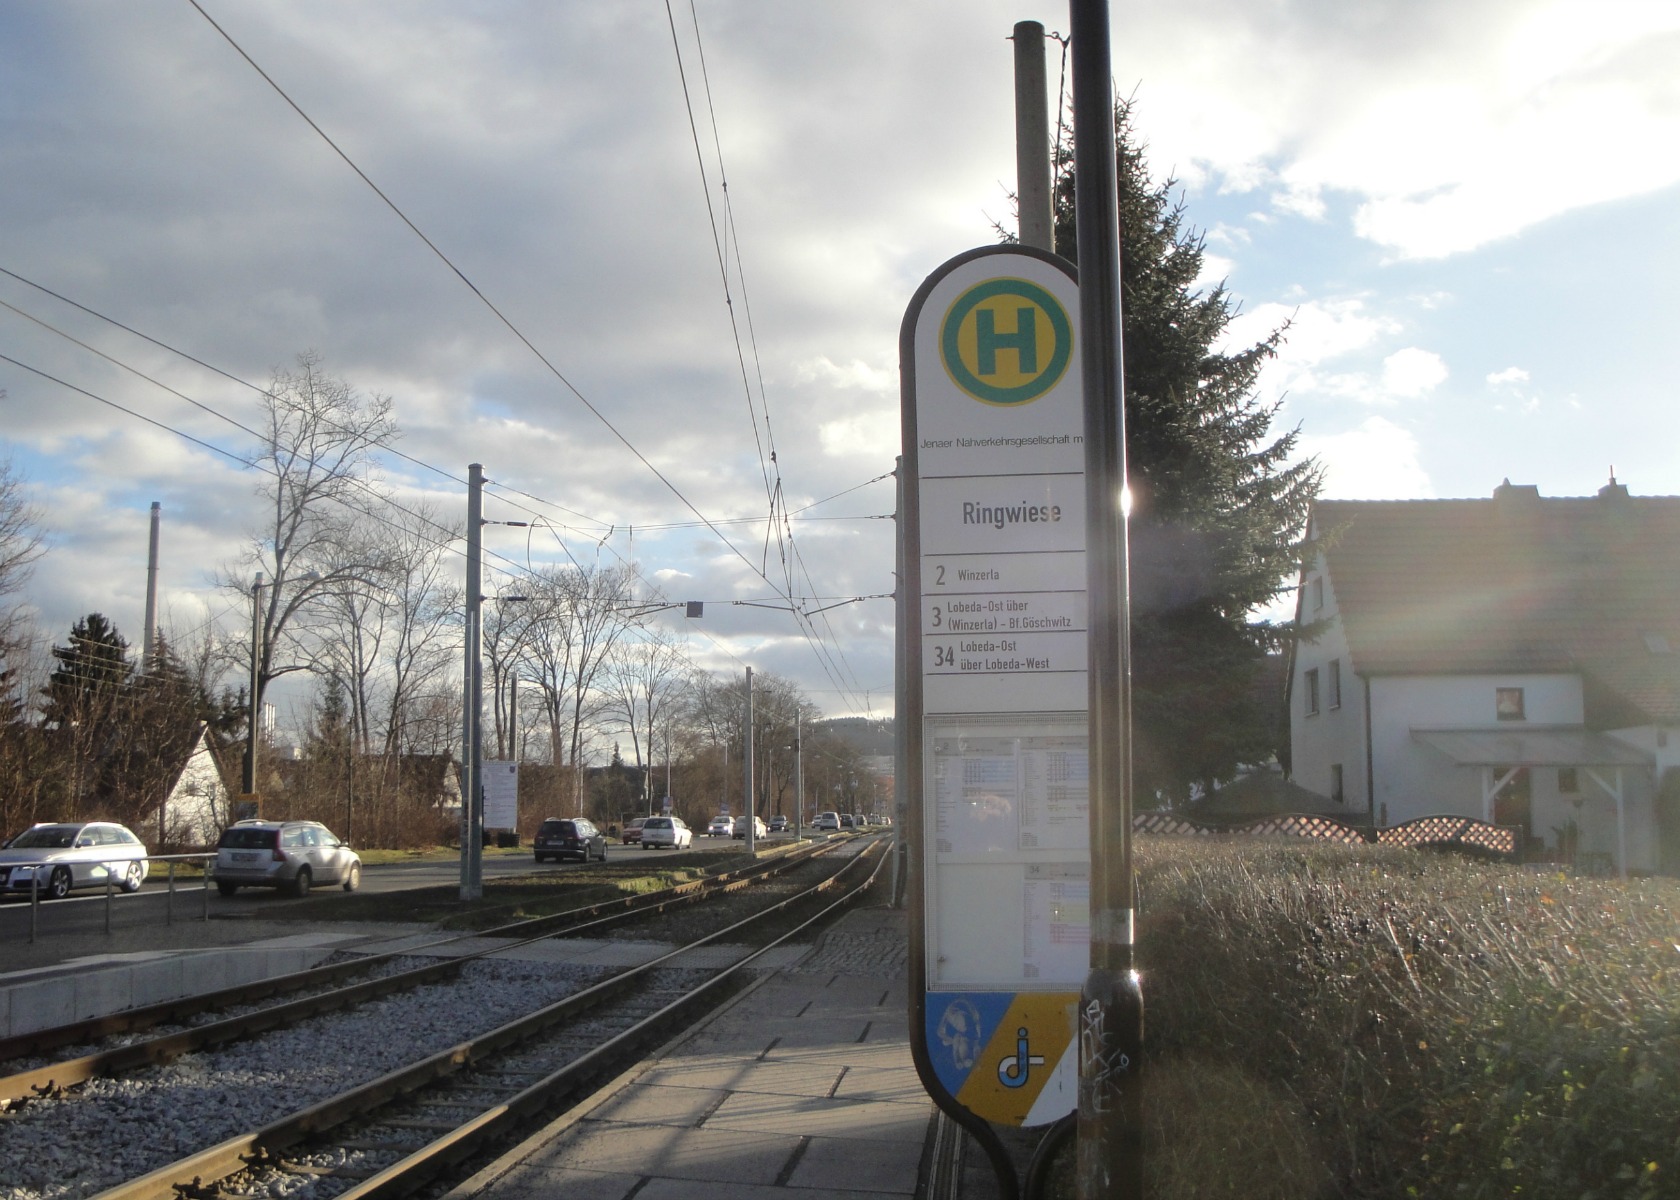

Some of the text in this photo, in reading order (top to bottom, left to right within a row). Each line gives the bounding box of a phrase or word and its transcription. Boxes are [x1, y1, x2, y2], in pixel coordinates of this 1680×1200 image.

[976, 307, 1037, 375] H
[920, 439, 953, 449] Jenaer
[956, 435, 1070, 447] Nahverkehrsgesellschaft
[963, 501, 1061, 530] Ringwiese
[935, 565, 946, 586] 2
[958, 569, 1000, 581] Winzerla
[947, 600, 1028, 613] Lobeda-Ost über
[932, 607, 942, 627] 3
[948, 616, 998, 631] (Winzerla)
[1009, 616, 1071, 629] Bf.Göschwitz
[960, 641, 1016, 653] Lobeda-Ost
[934, 646, 955, 667] 34
[960, 658, 1049, 671] über Lobeda-West
